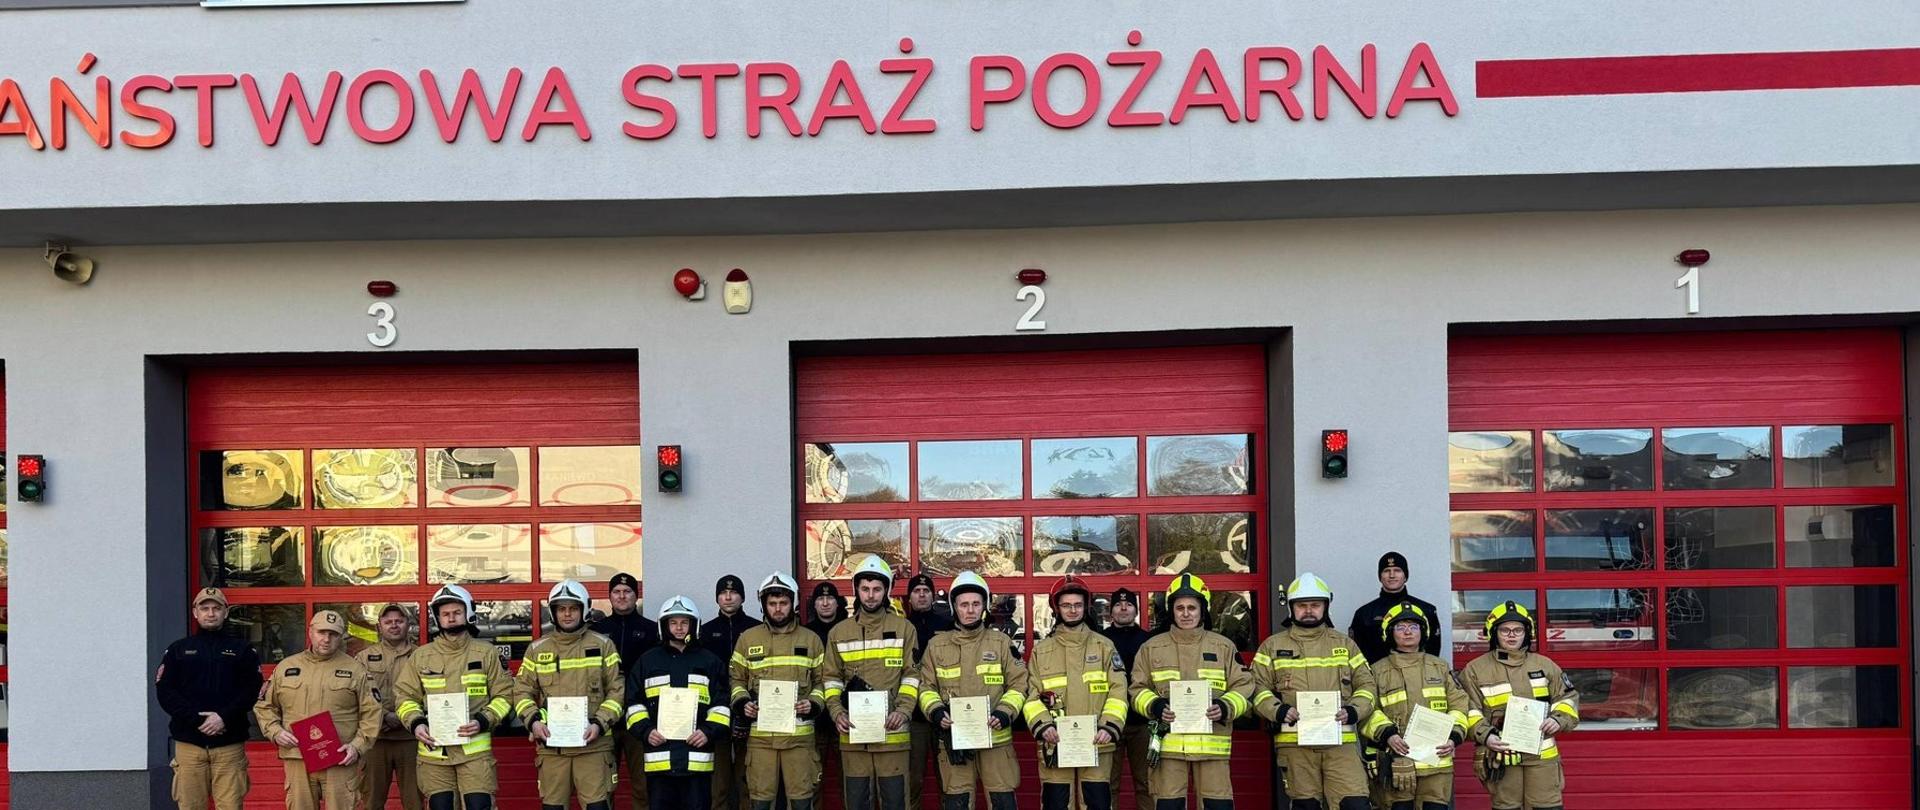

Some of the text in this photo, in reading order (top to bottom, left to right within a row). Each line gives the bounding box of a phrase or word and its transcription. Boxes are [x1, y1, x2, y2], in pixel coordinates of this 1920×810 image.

[622, 38, 935, 139] STRAŻ
[971, 31, 1459, 131] POŻARNA
[1016, 285, 1046, 331] 2
[1676, 267, 1699, 314] 1
[367, 301, 397, 347] 3
